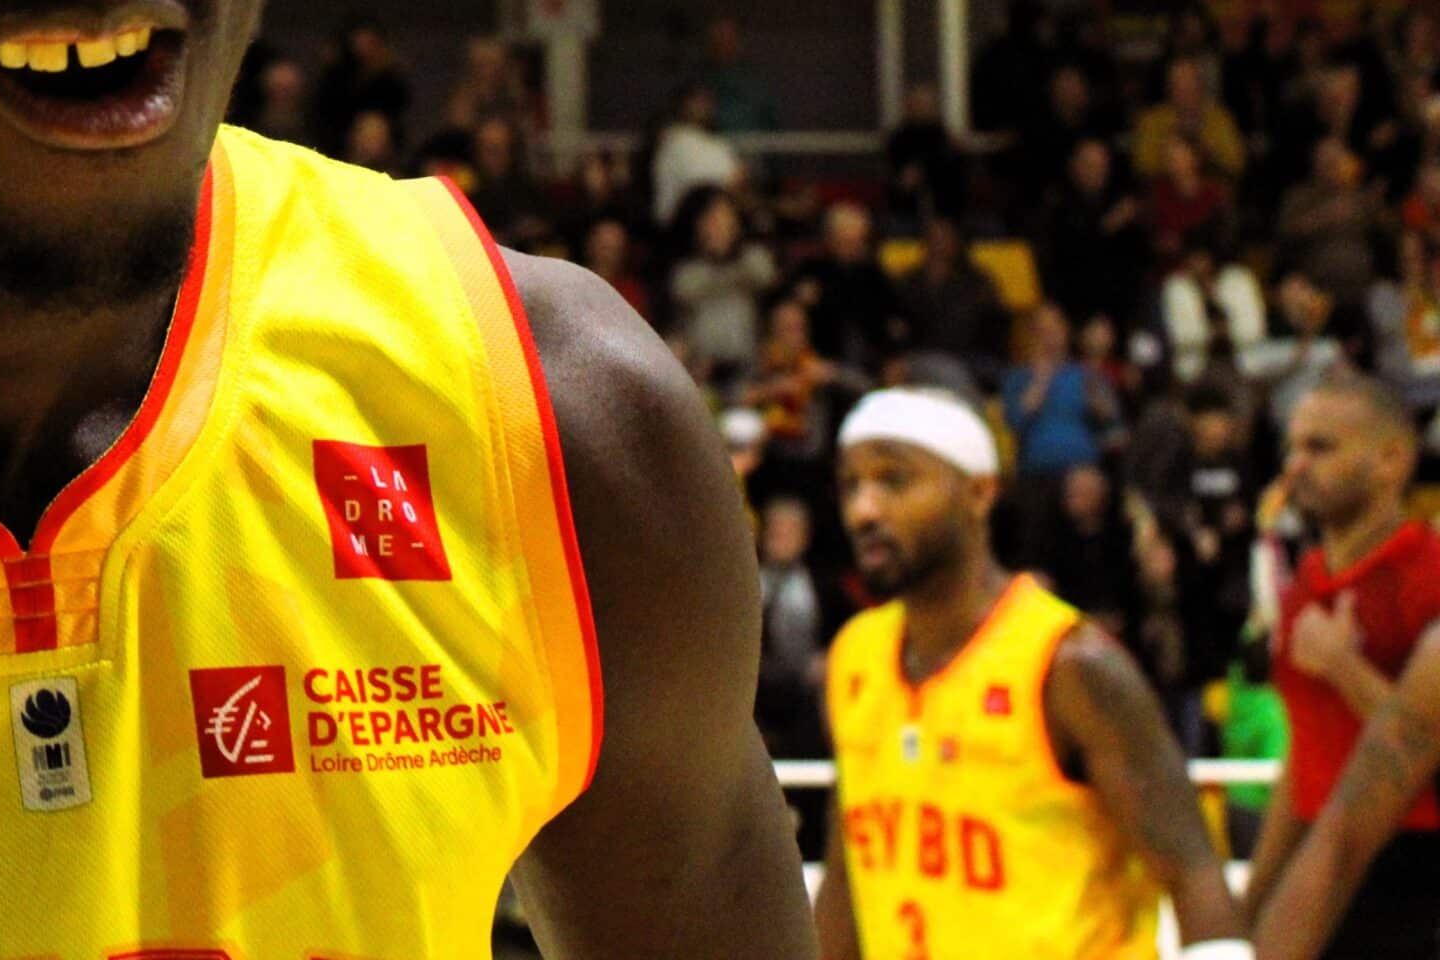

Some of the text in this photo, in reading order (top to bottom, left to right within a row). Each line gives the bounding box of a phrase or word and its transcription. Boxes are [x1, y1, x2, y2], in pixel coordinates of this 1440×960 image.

[303, 664, 444, 706] CAISSE
[307, 700, 515, 748] D'EPARGNE
[309, 742, 502, 773] Loire Drôme Ardèche
